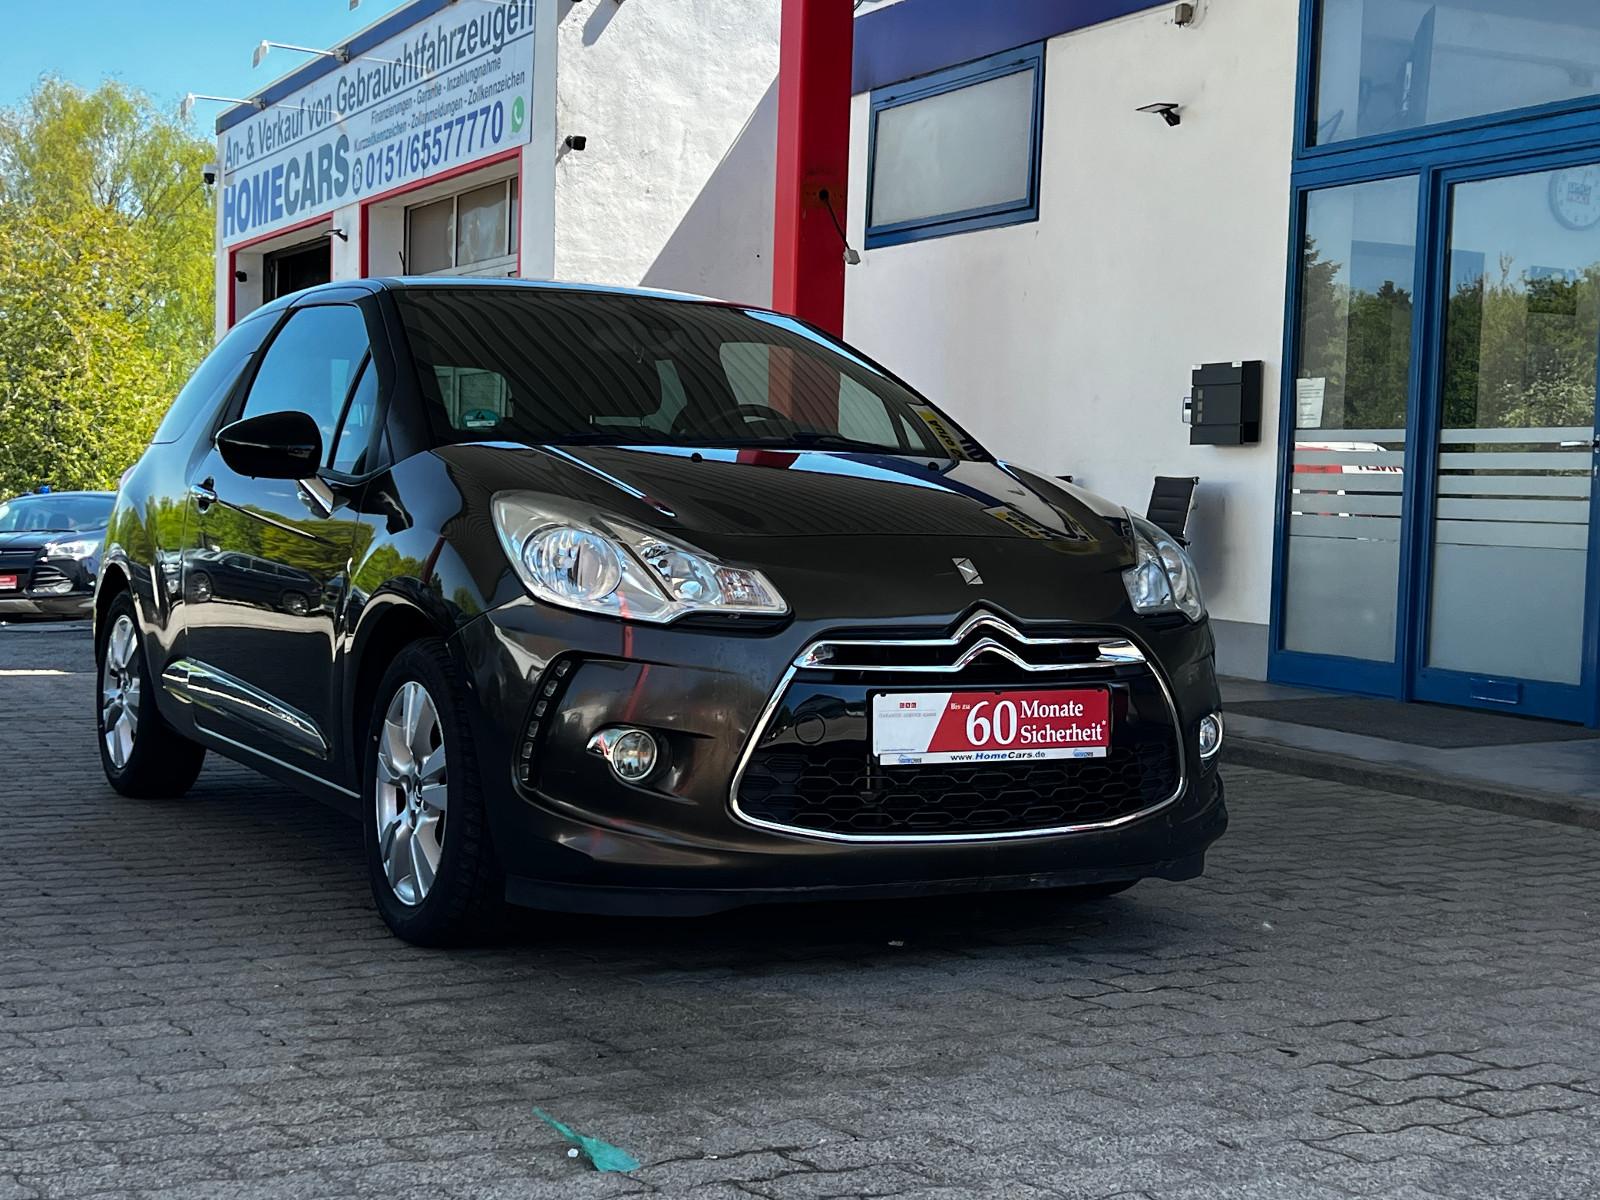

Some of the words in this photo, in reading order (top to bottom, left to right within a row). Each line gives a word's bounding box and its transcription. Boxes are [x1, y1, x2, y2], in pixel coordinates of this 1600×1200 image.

[224, 136, 244, 171] An-
[246, 125, 255, 161] &
[258, 97, 305, 154] Verkauf
[308, 94, 332, 131] von
[336, 0, 533, 116] Gebrauchtfahrzeugen
[371, 97, 413, 125] Finanzierungen
[417, 82, 442, 105] Garantie
[446, 57, 501, 93] Inzahlungnahme
[467, 71, 525, 106] Zollkennzeichen
[366, 100, 504, 190] 0151/65577770
[223, 134, 349, 238] HOMECARS
[966, 700, 1018, 746] 60
[1020, 700, 1084, 718] Monate
[950, 750, 1046, 761] www.HomeCars.de
